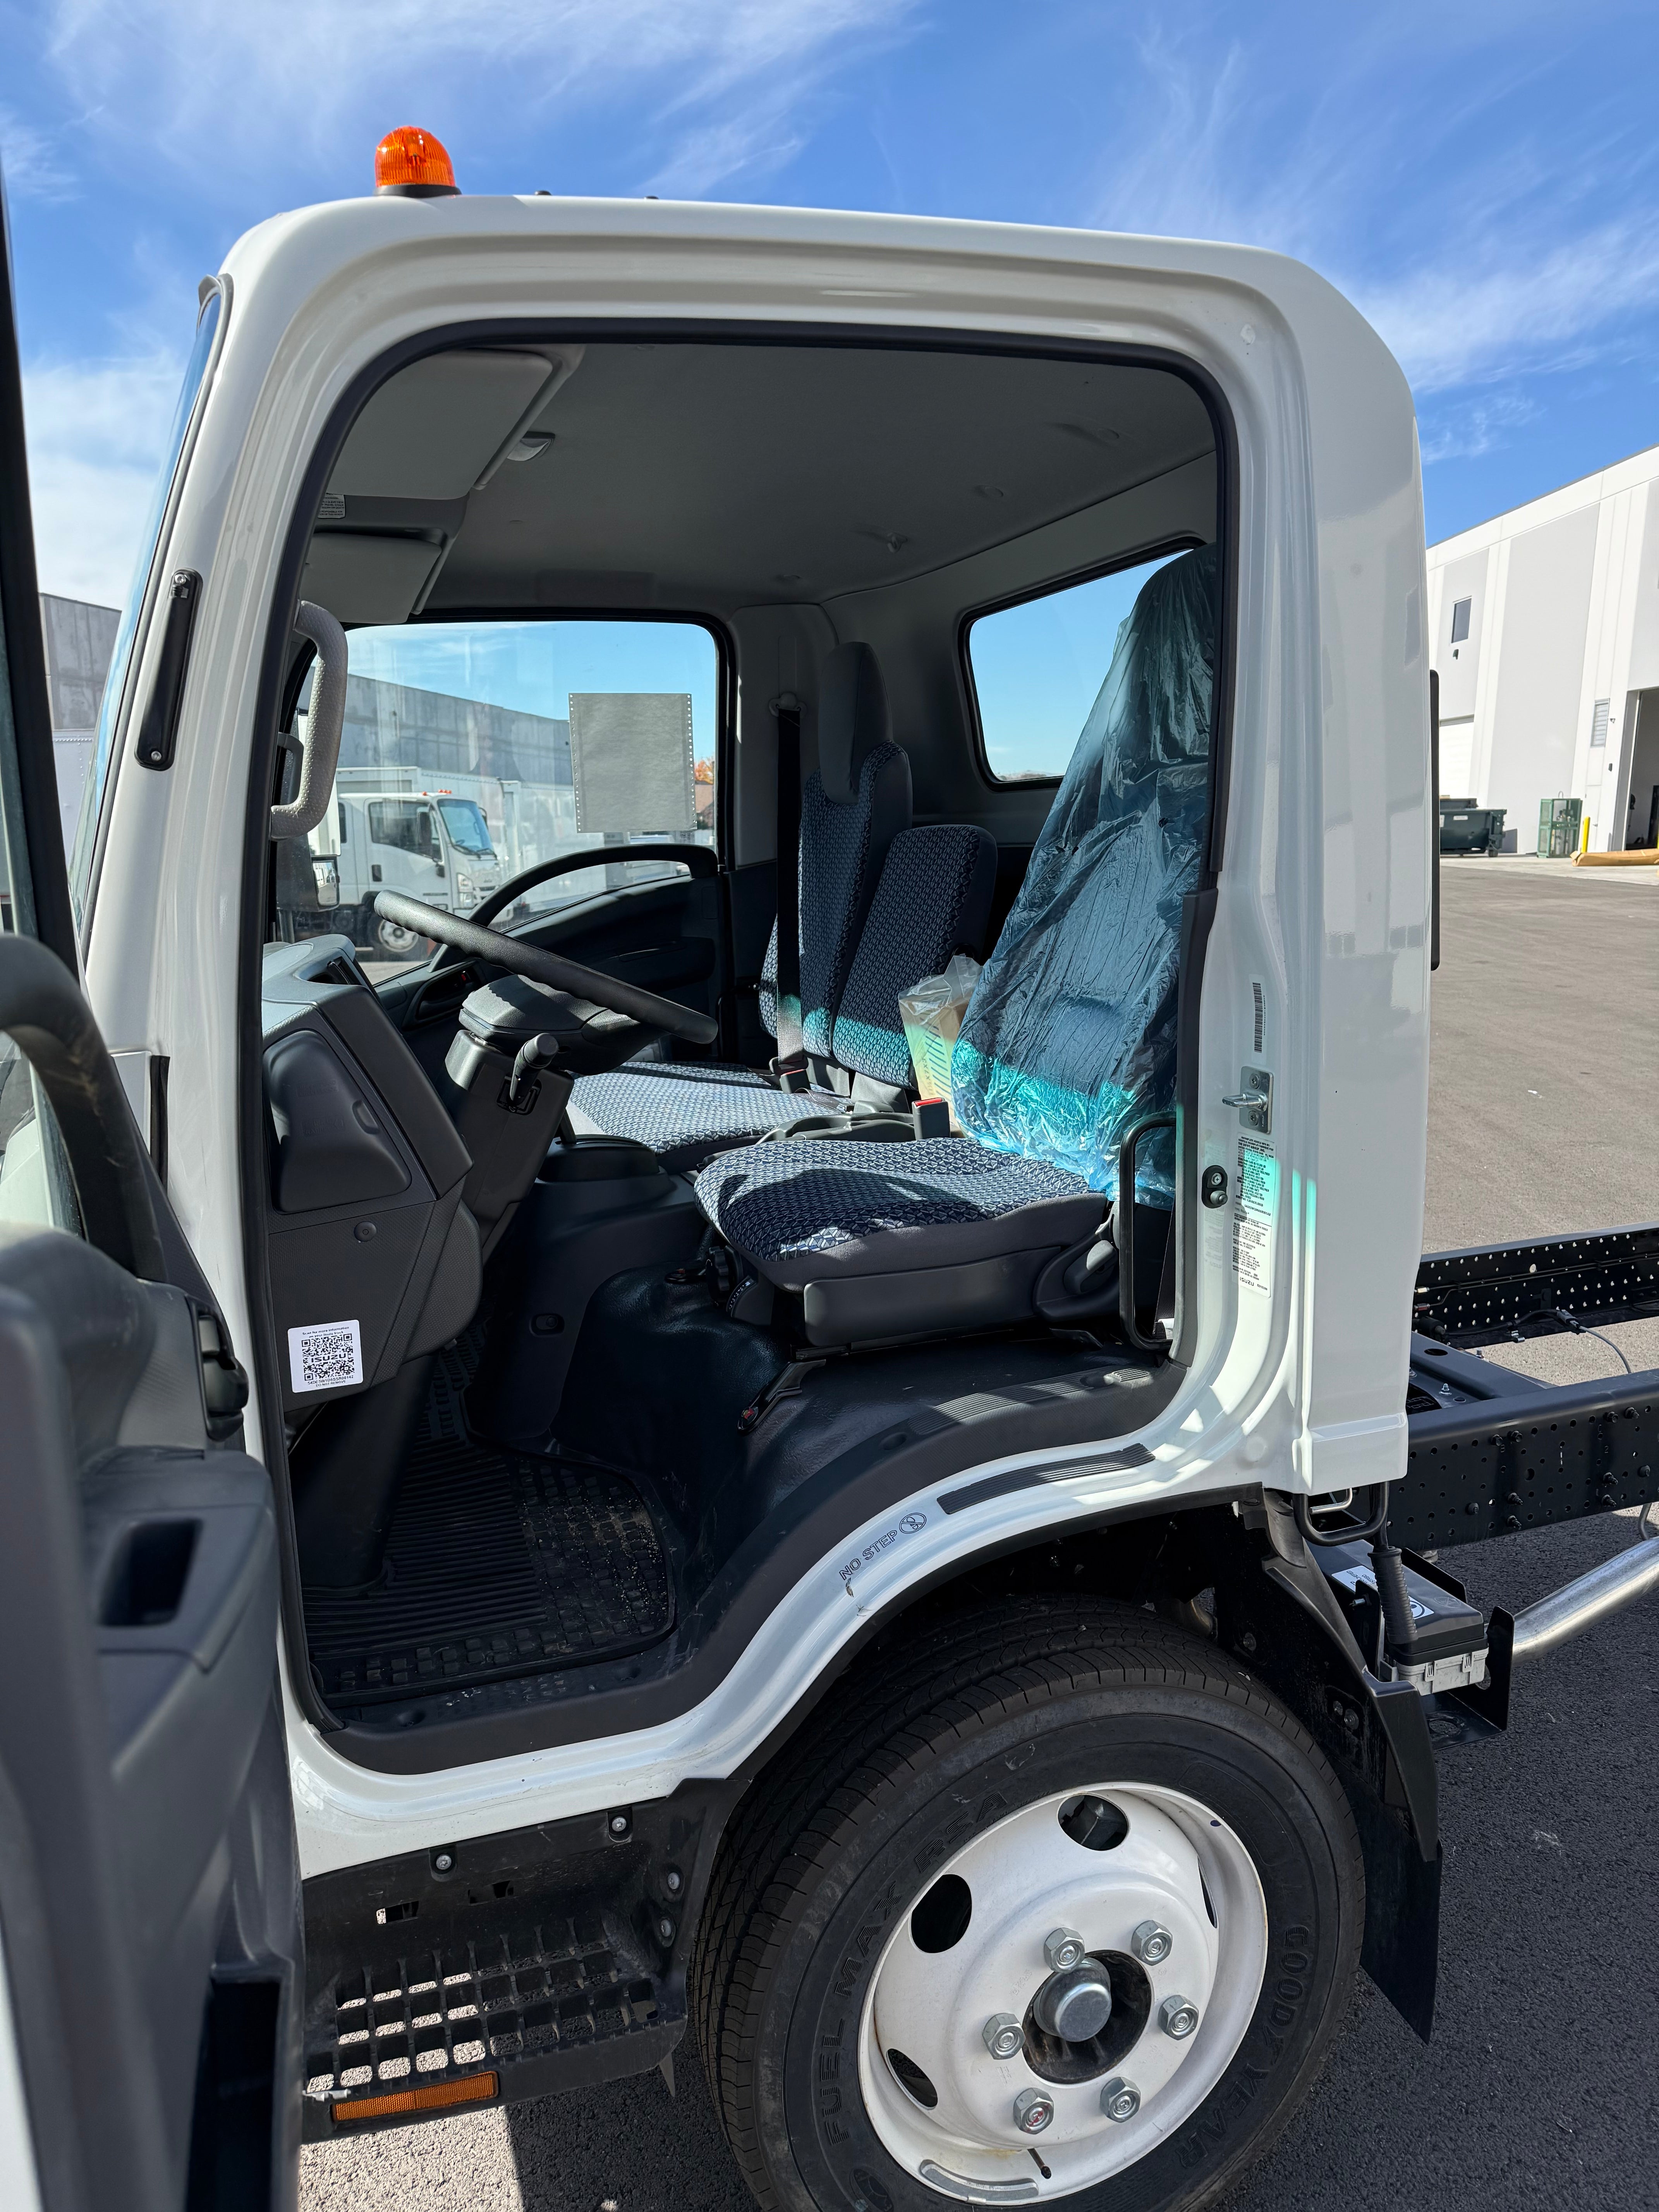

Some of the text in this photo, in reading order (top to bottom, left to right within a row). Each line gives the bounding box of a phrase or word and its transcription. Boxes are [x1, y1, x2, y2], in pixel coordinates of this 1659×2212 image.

[1240, 1276, 1254, 1286] ISUZU
[311, 1353, 346, 1363] ISUZU
[1604, 1445, 1609, 1453] 2
[839, 1530, 897, 1581] NO STEP
[819, 1791, 1008, 2147] FUEL MAX RSA
